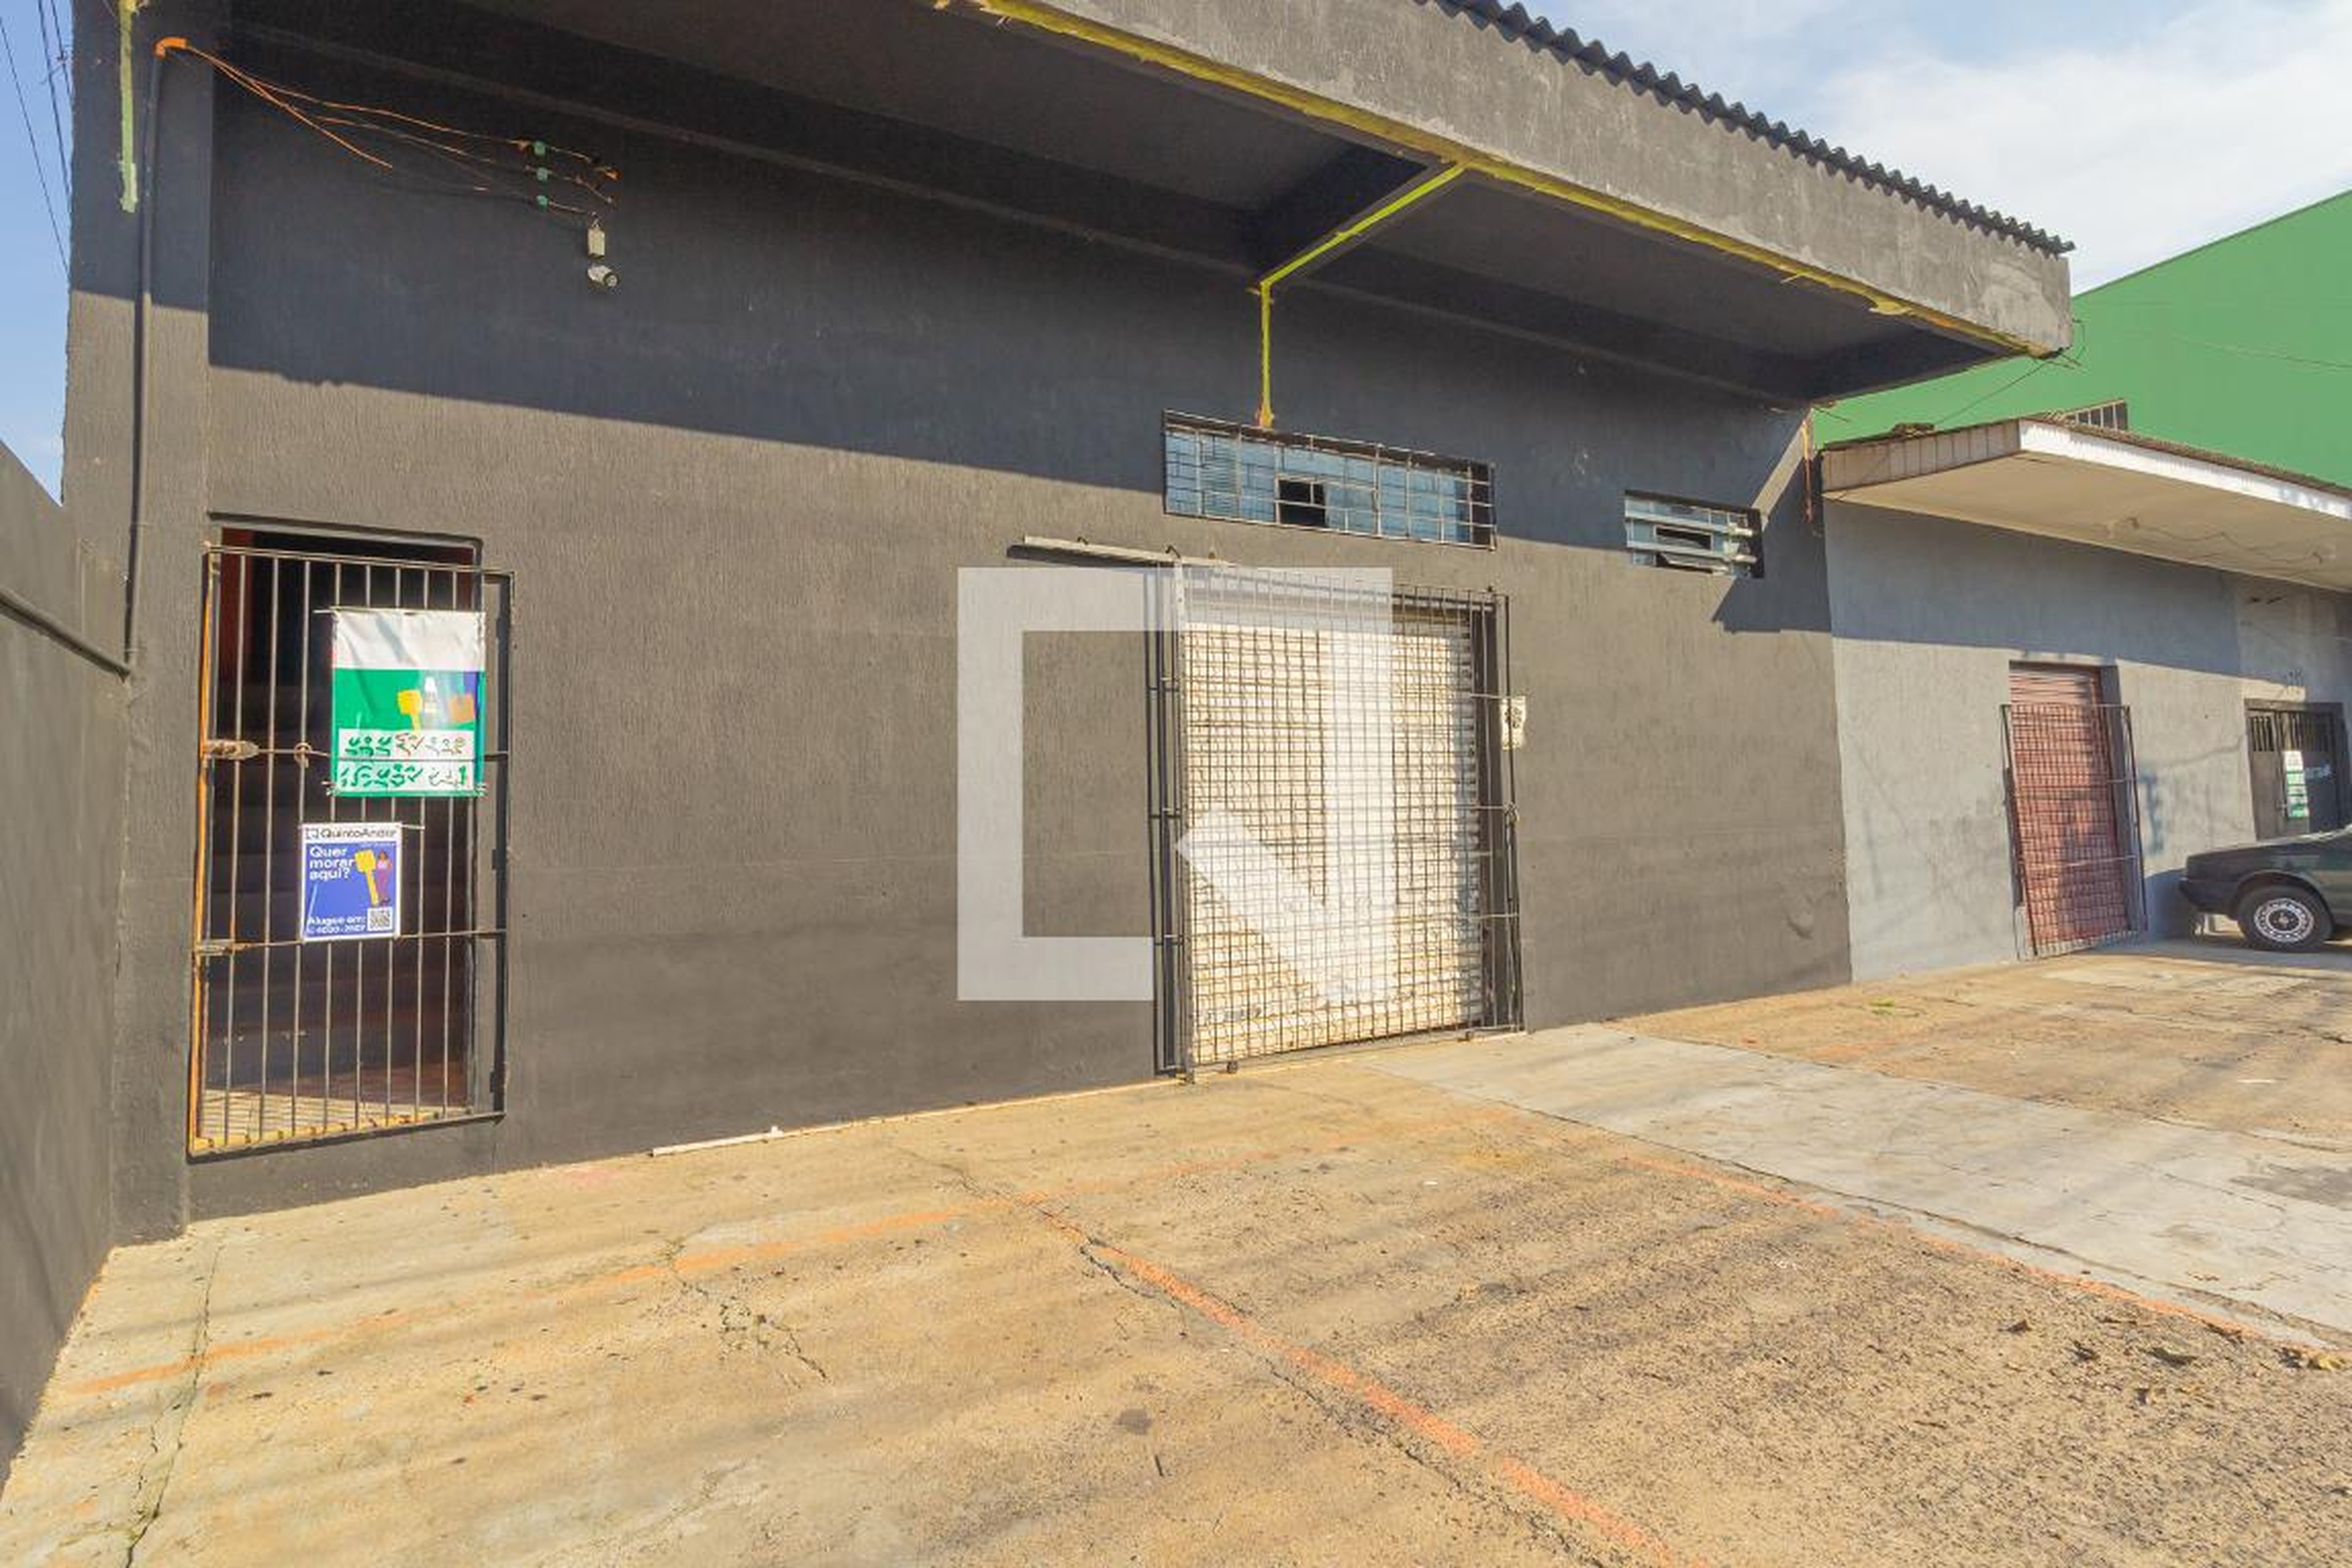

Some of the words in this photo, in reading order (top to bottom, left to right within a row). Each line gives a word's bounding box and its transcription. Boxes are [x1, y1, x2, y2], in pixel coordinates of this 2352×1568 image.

[309, 845, 347, 858] Quer
[310, 859, 355, 869] morar
[309, 868, 350, 881] aqui?
